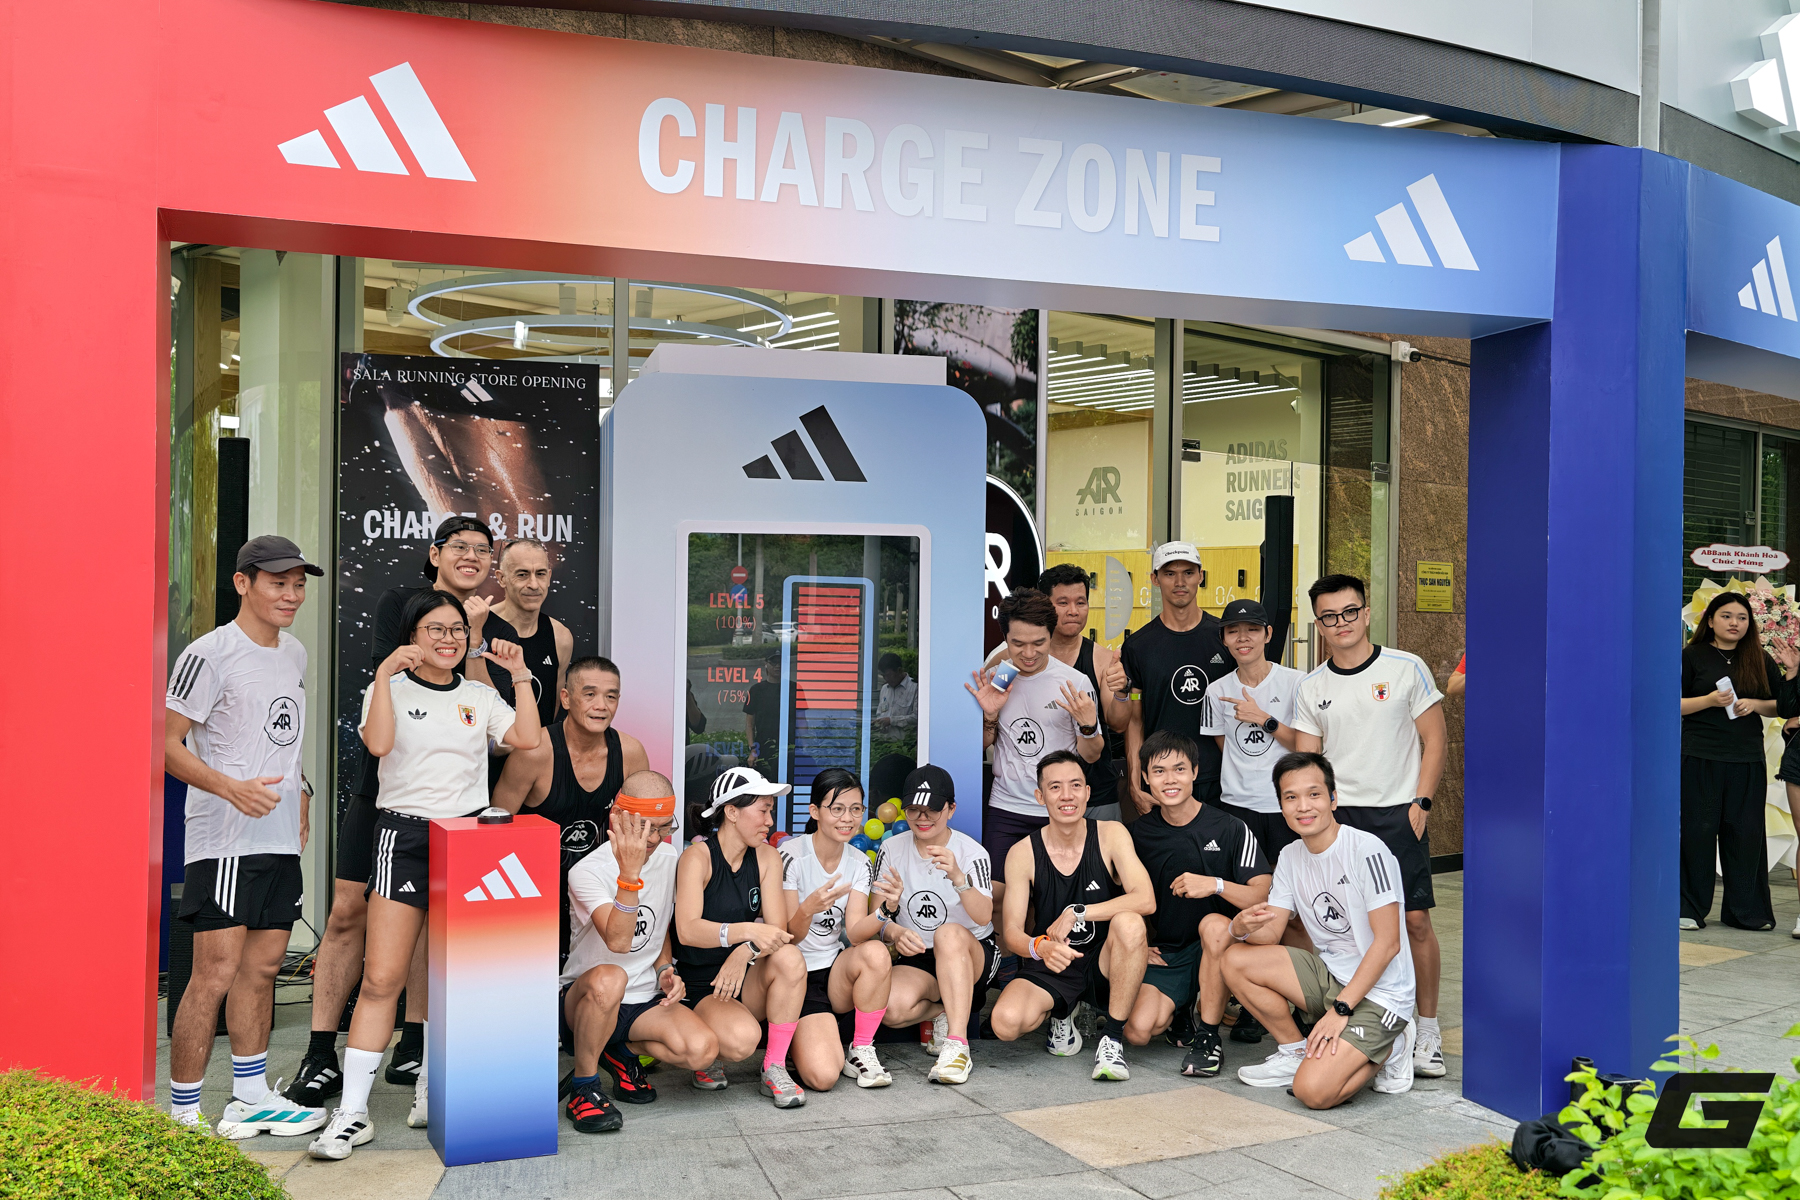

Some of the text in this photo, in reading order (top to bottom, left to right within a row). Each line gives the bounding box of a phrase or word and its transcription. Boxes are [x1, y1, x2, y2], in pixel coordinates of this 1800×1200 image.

[638, 97, 1222, 243] CHARGE ZONE
[353, 368, 587, 390] SALA RUNNING STORE OPENING
[1225, 438, 1288, 466] ADIDAS
[1076, 466, 1122, 505] AR
[1075, 506, 1123, 517] SAIGON
[1225, 498, 1266, 522] SAIG
[363, 509, 573, 543] CHAR & RUN
[1701, 549, 1732, 557] ABBank
[1734, 550, 1760, 558] Khánh
[984, 532, 1012, 600] R
[709, 593, 765, 610] LEVEL 5
[715, 615, 757, 631] (100%)
[707, 666, 763, 683] LEVEL 4
[1180, 677, 1200, 693] AR
[717, 690, 751, 705] (75%)
[272, 713, 292, 731] AR
[1016, 731, 1037, 744] AR
[1244, 730, 1265, 744] AR
[705, 741, 748, 757] LEVEL
[565, 829, 589, 843] AR
[916, 904, 938, 919] AR
